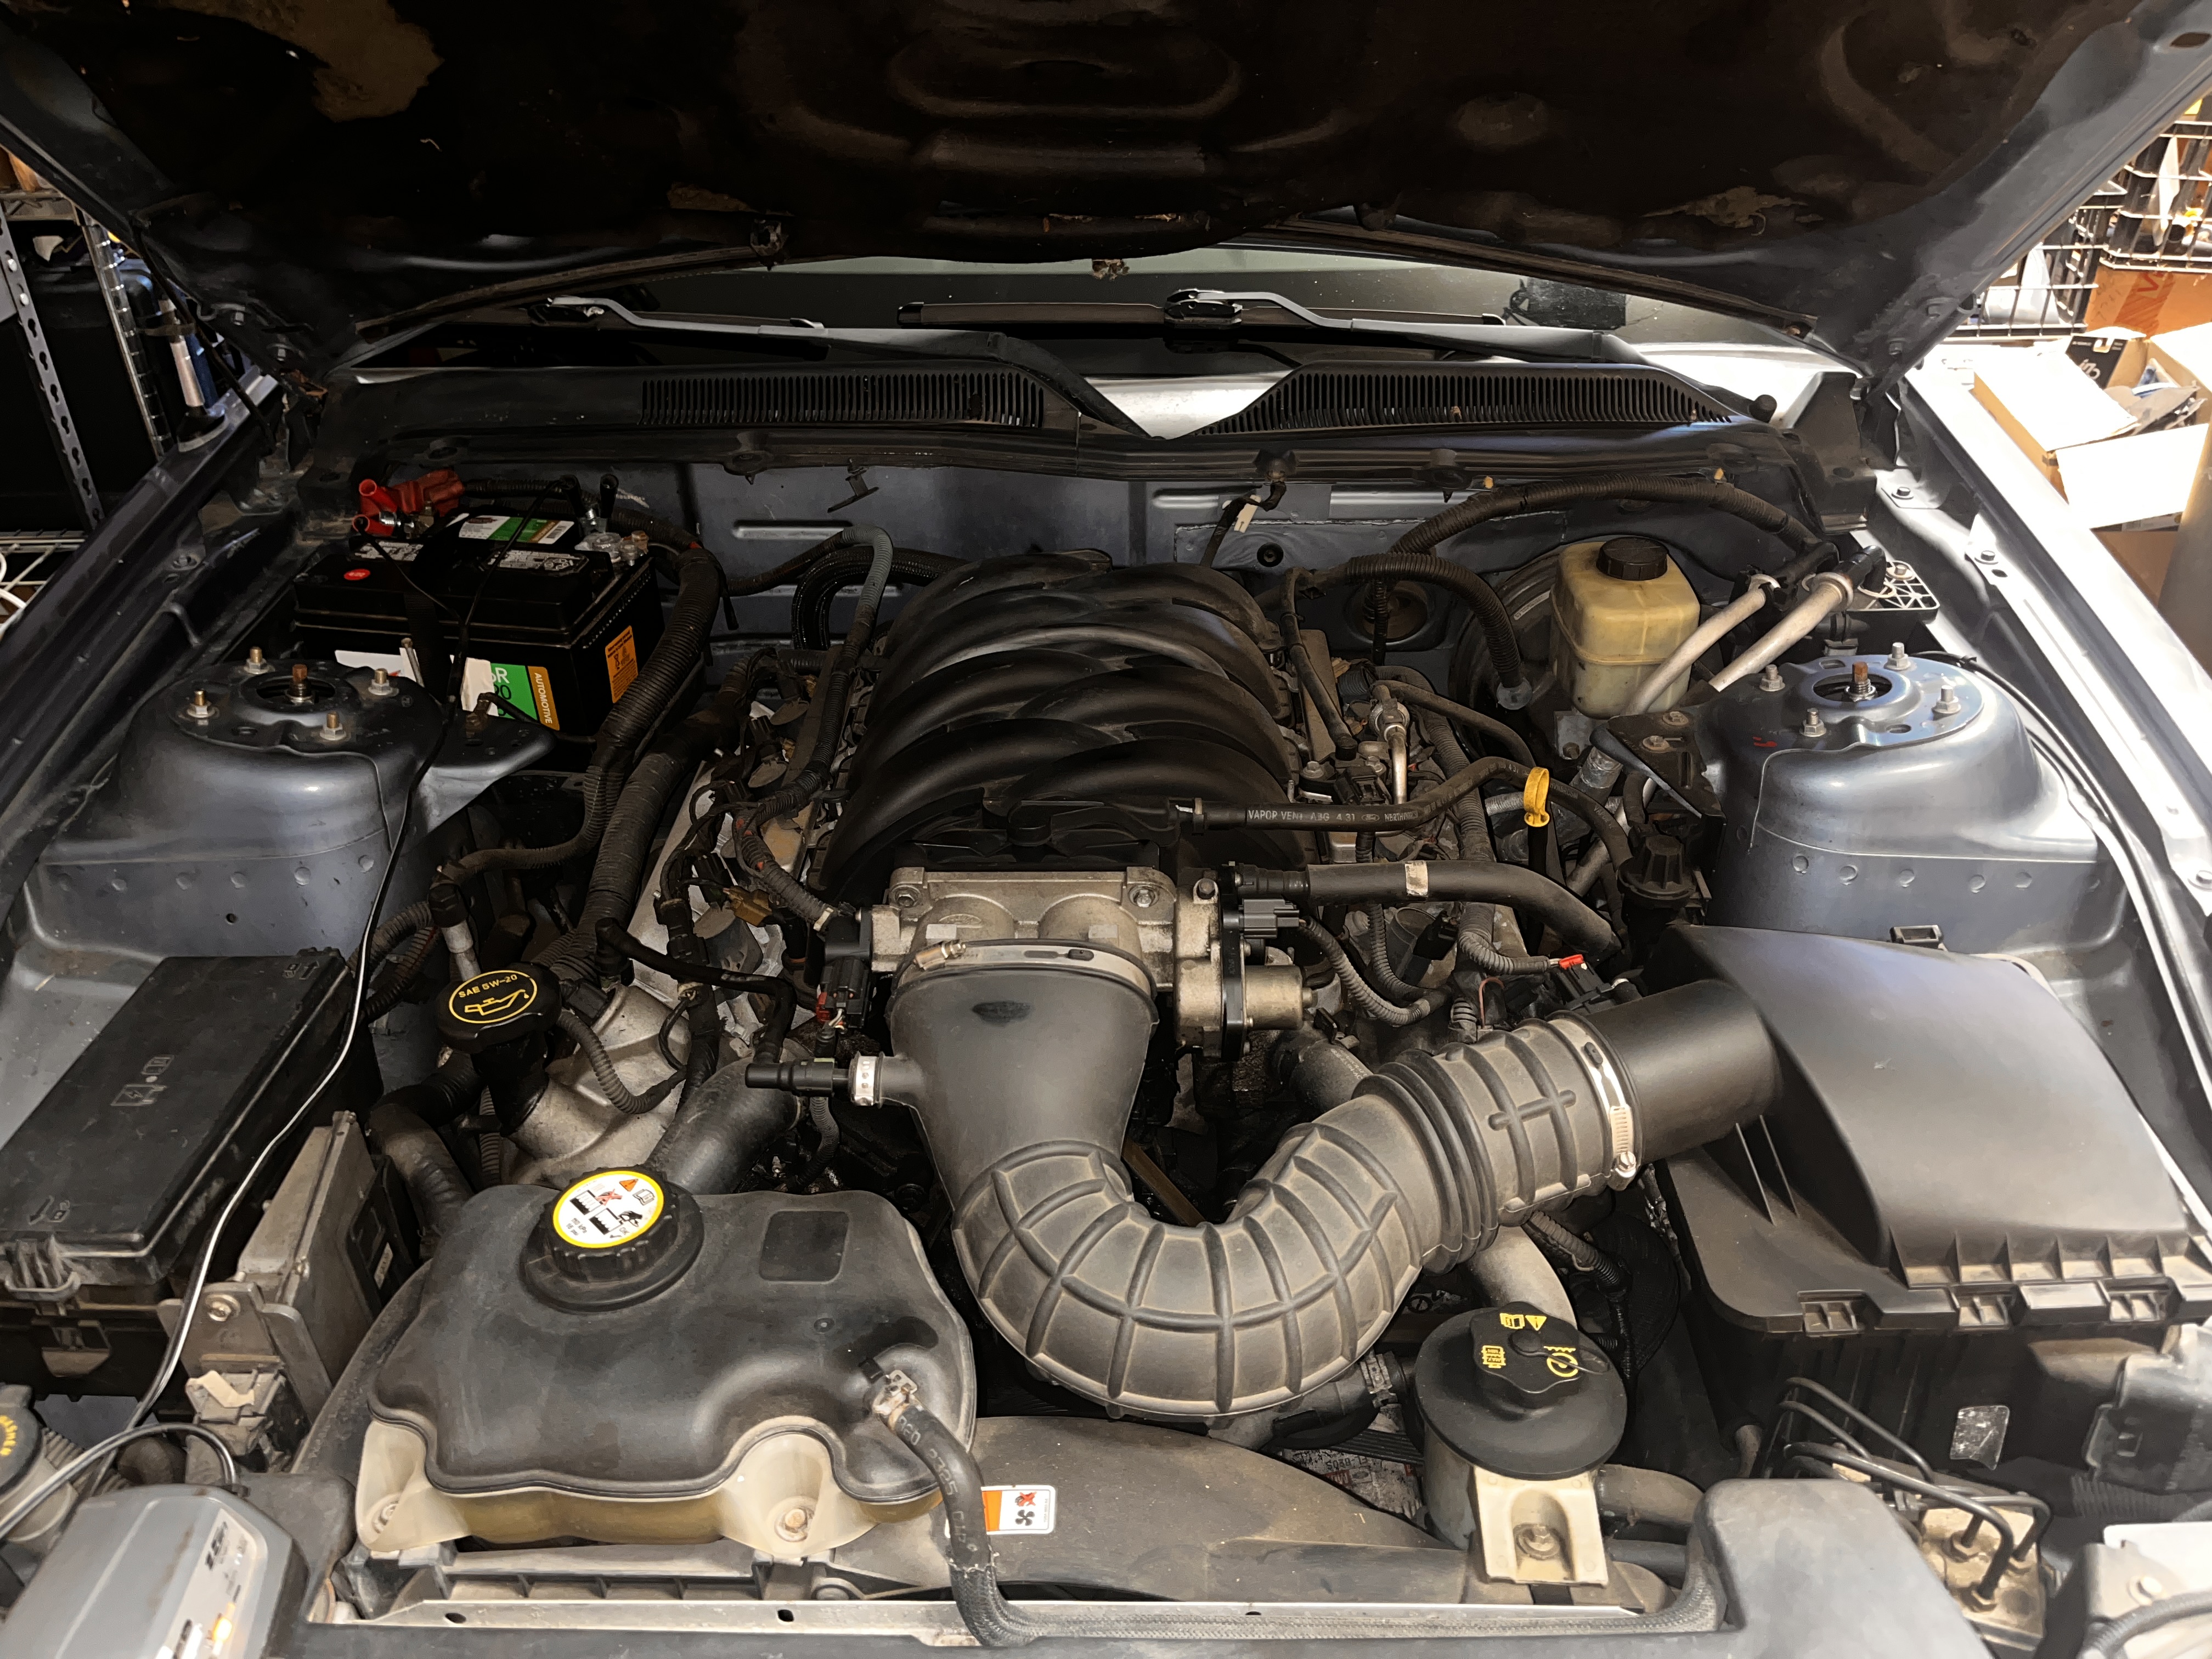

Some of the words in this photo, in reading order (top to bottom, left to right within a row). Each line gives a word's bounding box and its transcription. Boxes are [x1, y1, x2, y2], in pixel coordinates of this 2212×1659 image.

[534, 673, 553, 724] AUTOMOTIVE
[1248, 810, 1278, 821] VAPOR
[459, 986, 481, 998] SAE
[482, 974, 518, 990] 5W-20
